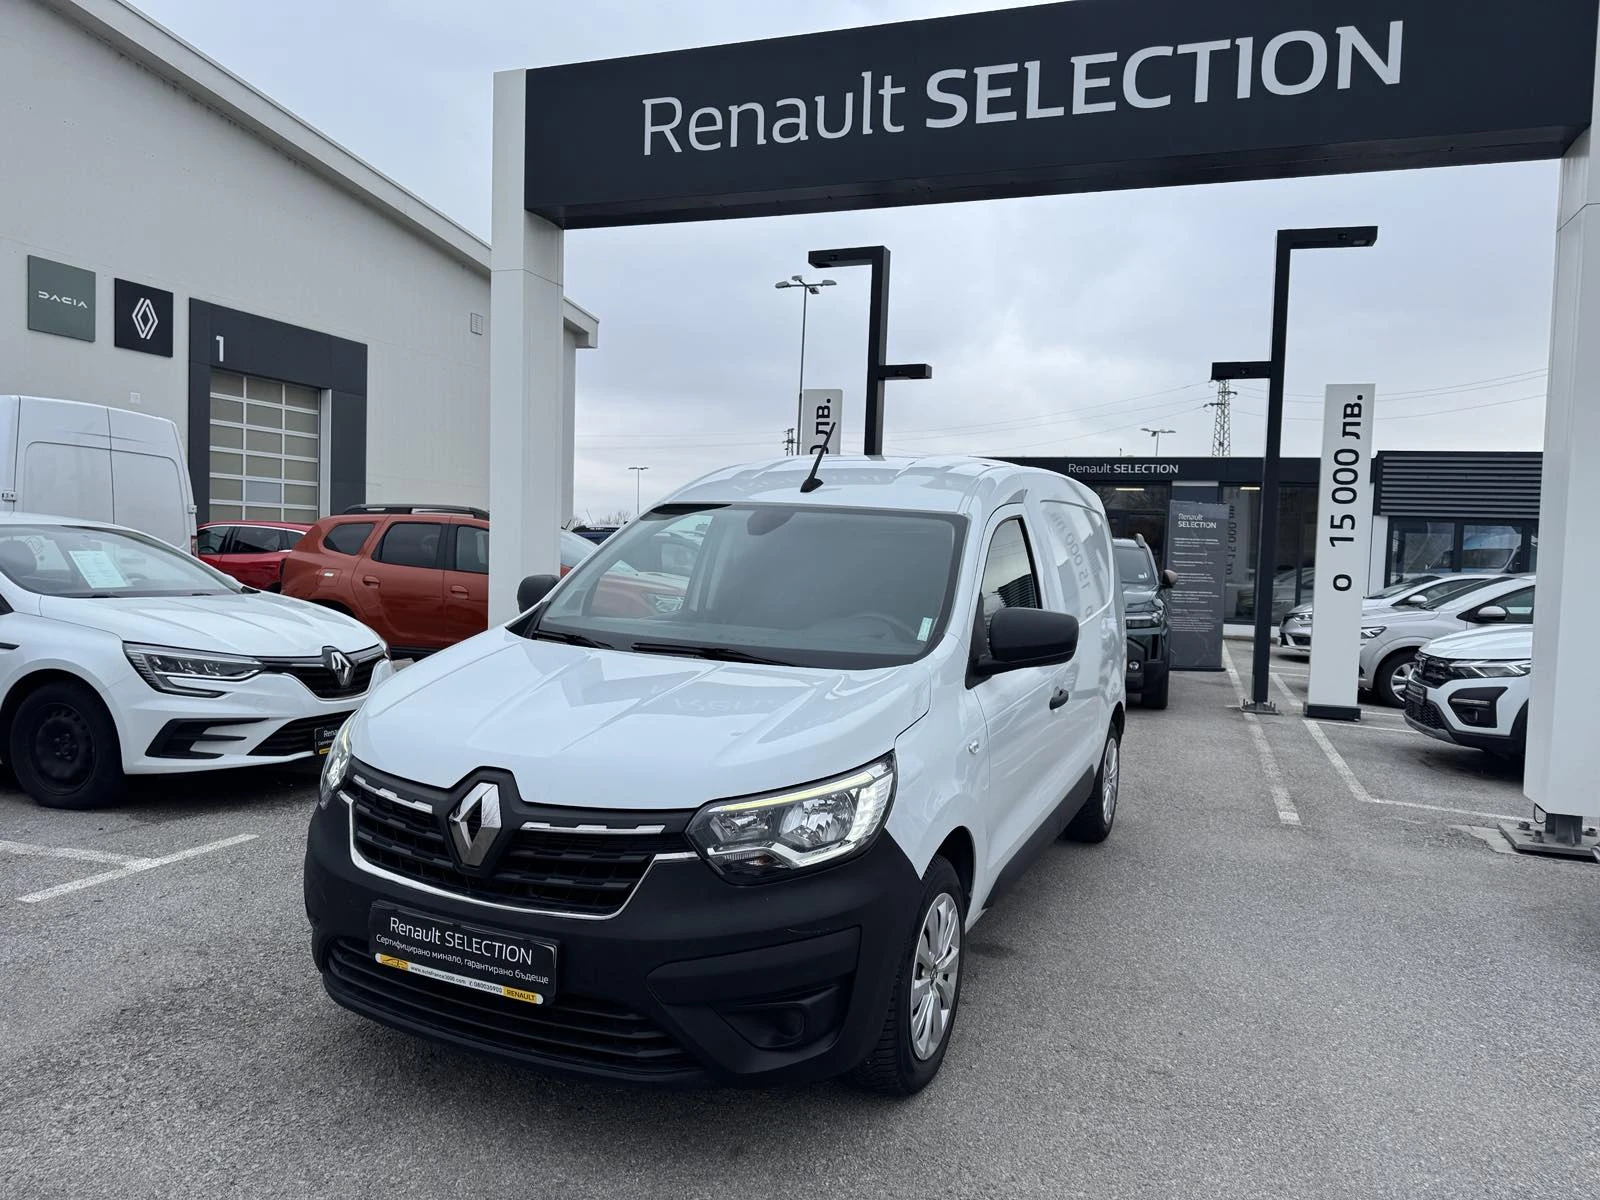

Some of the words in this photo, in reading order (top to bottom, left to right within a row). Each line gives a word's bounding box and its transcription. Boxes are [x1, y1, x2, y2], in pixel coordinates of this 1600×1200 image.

[642, 71, 906, 156] Renault
[925, 20, 1404, 129] SELECTION
[38, 290, 88, 309] DACIA
[215, 335, 224, 362] 1
[1342, 394, 1364, 440] лв.
[1068, 463, 1112, 474] Renault
[1113, 464, 1179, 474] SELECTION
[1331, 448, 1360, 505] 000
[1178, 512, 1204, 521] Renault
[1178, 520, 1217, 529] SELECTION
[1329, 514, 1356, 548] 15
[390, 916, 441, 945] Renault
[444, 931, 533, 966] SELECTION
[375, 934, 431, 957] Сертифицирано
[431, 951, 463, 967] минало,
[464, 958, 513, 978] гарантирано
[514, 969, 549, 985] бъдеще
[506, 989, 536, 1001] RENAULT
